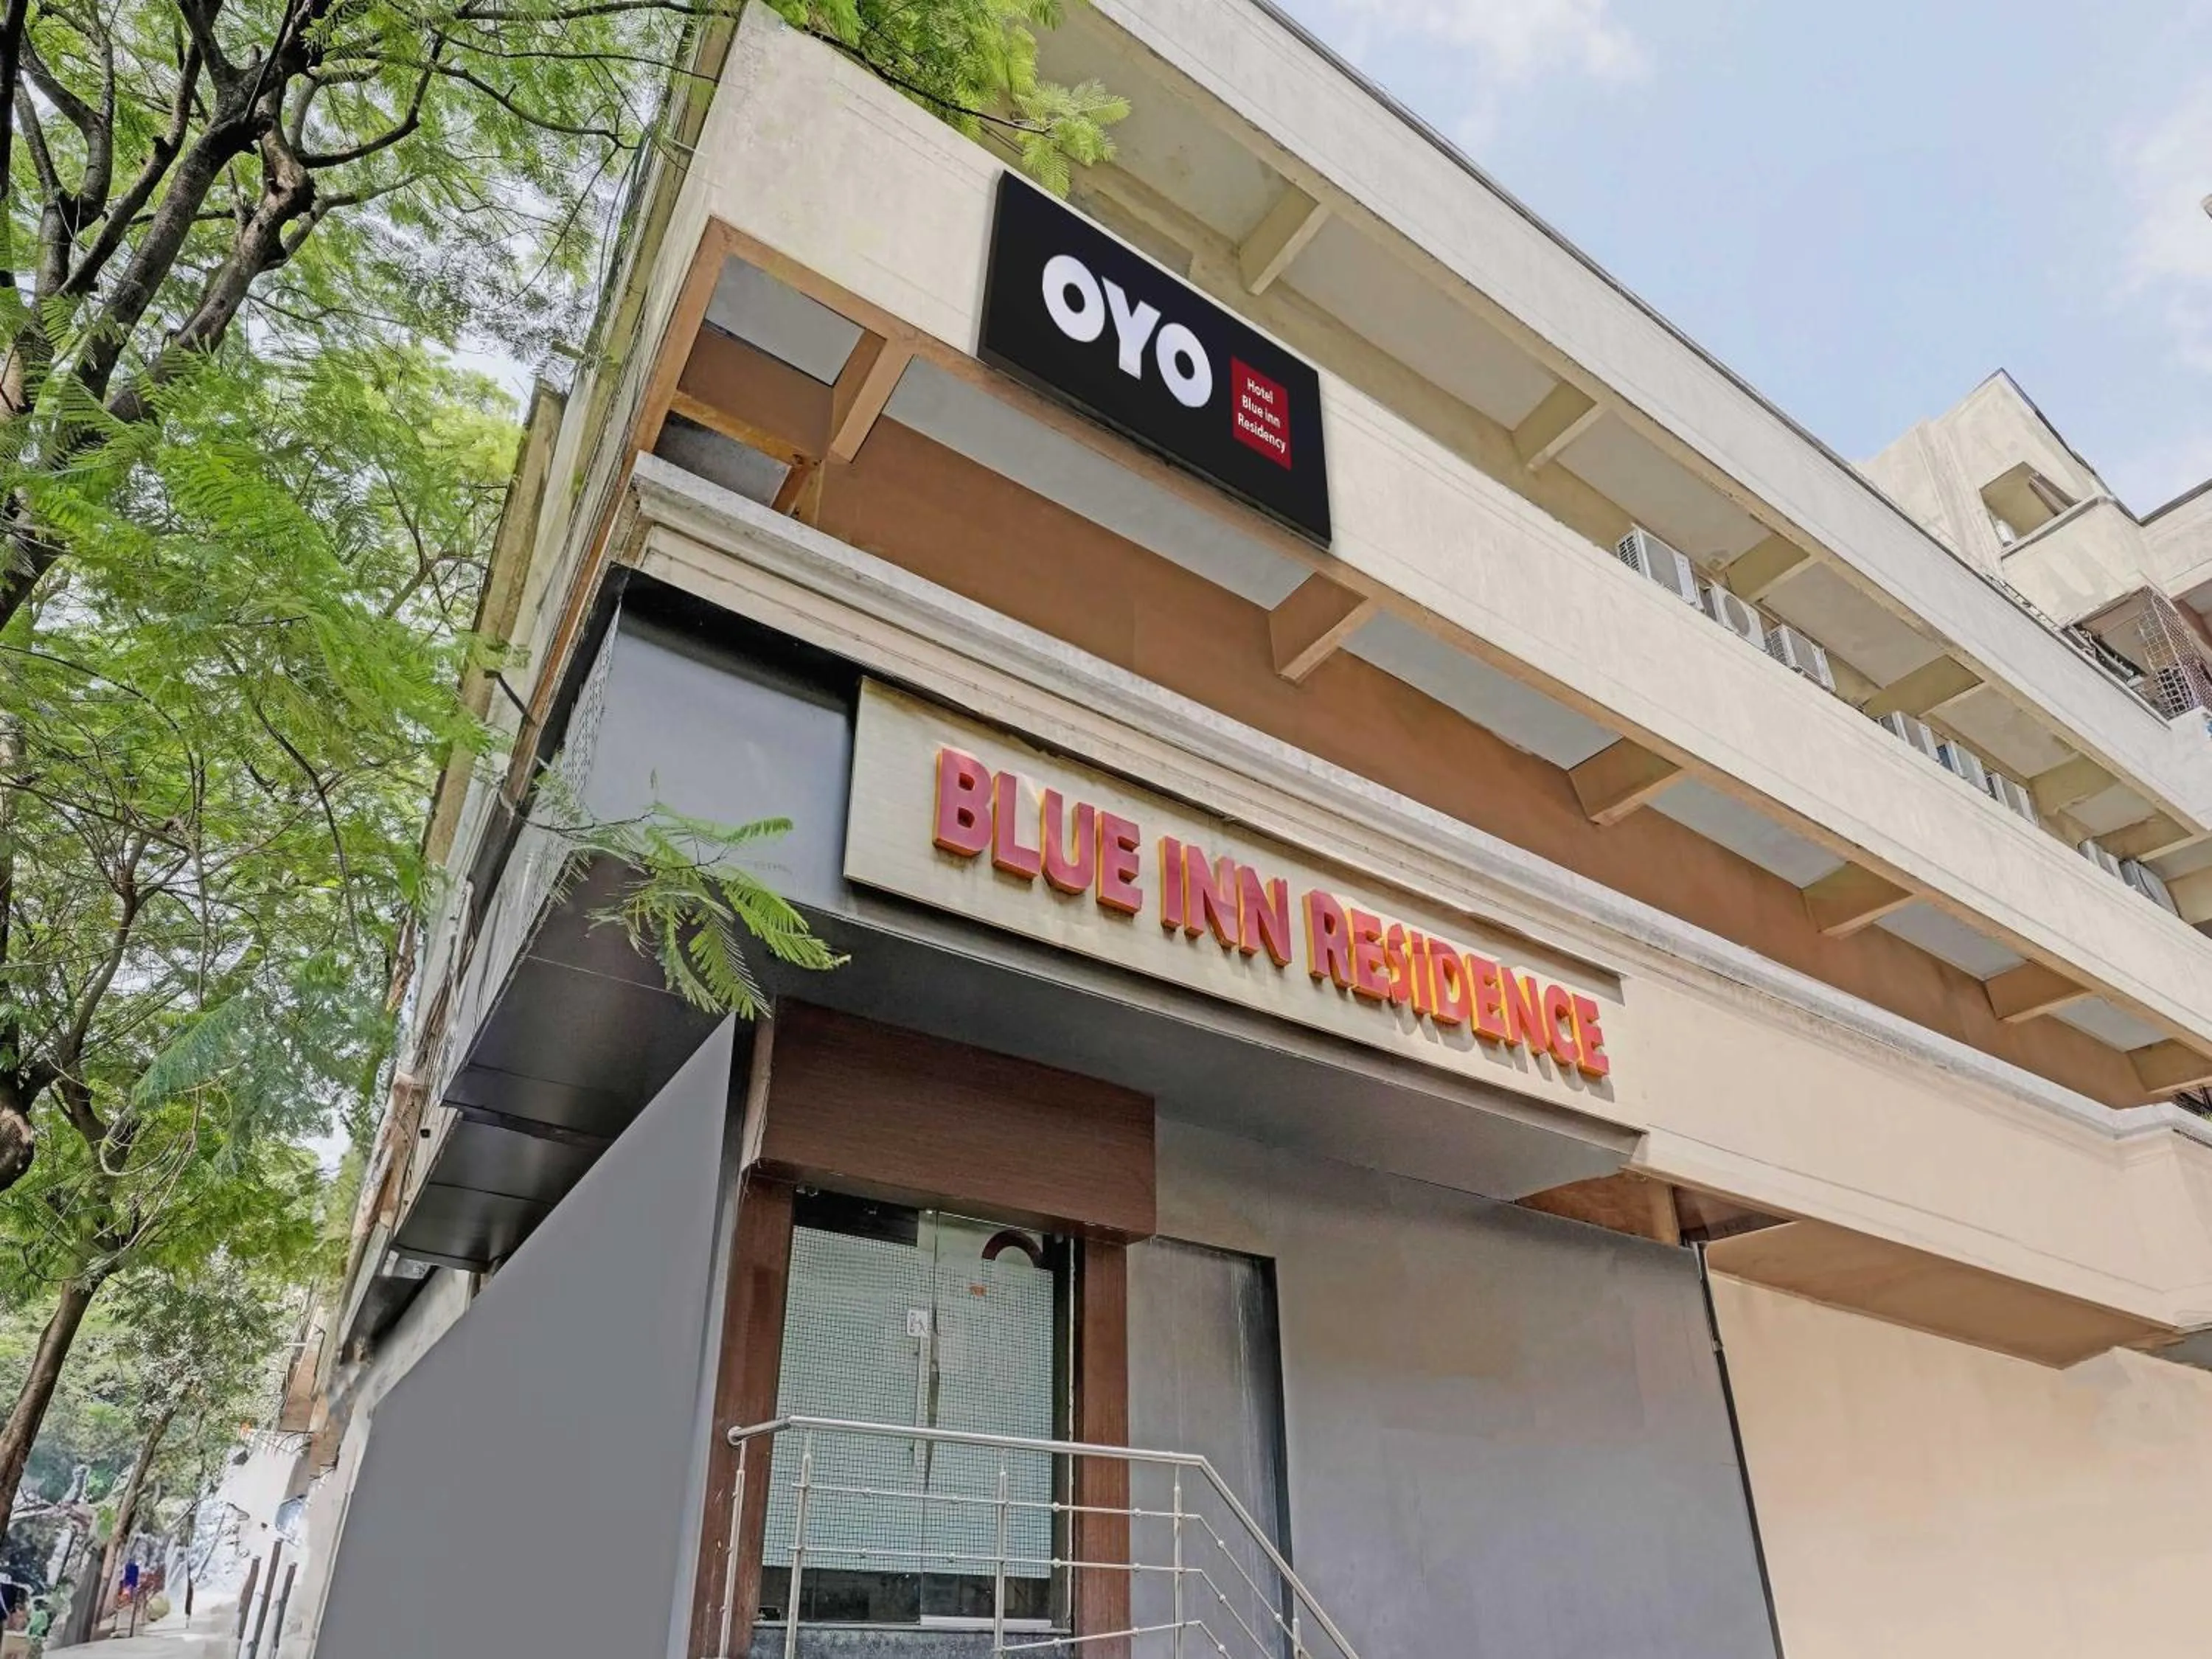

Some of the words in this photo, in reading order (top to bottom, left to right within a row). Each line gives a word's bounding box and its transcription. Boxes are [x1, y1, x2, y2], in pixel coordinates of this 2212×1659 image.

[1043, 255, 1212, 408] OYO
[1242, 395, 1263, 417] Blue
[1247, 378, 1273, 403] Hotel
[1238, 413, 1286, 453] Residency
[933, 748, 1144, 914] BLUE
[1161, 835, 1293, 967] INN
[1303, 889, 1609, 1077] RESIDENCE
